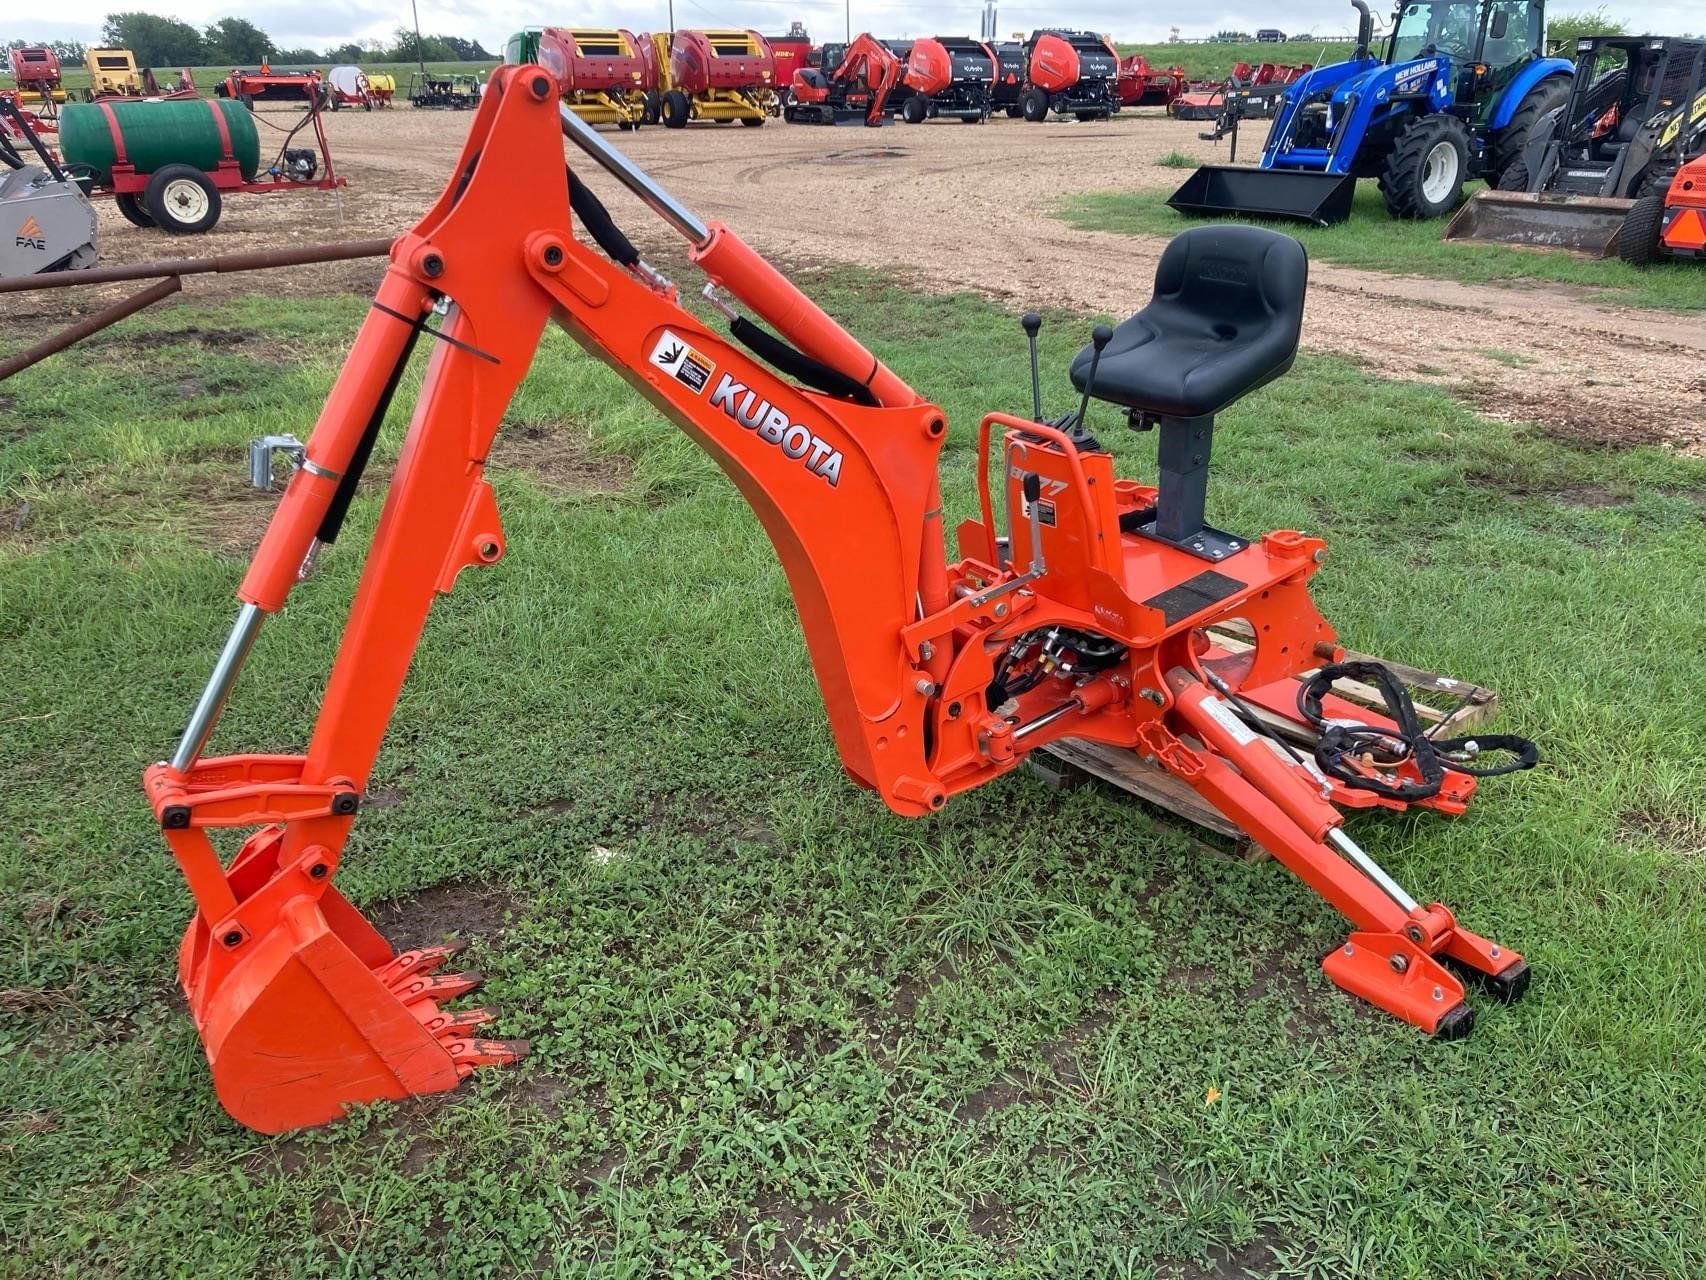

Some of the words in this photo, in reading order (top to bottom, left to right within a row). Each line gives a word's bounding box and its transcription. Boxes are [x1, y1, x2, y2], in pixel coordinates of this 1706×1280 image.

[1395, 67, 1410, 81] NEW
[1410, 59, 1437, 76] HOLLAND
[16, 237, 46, 250] FAE
[709, 372, 845, 487] KUBOTA
